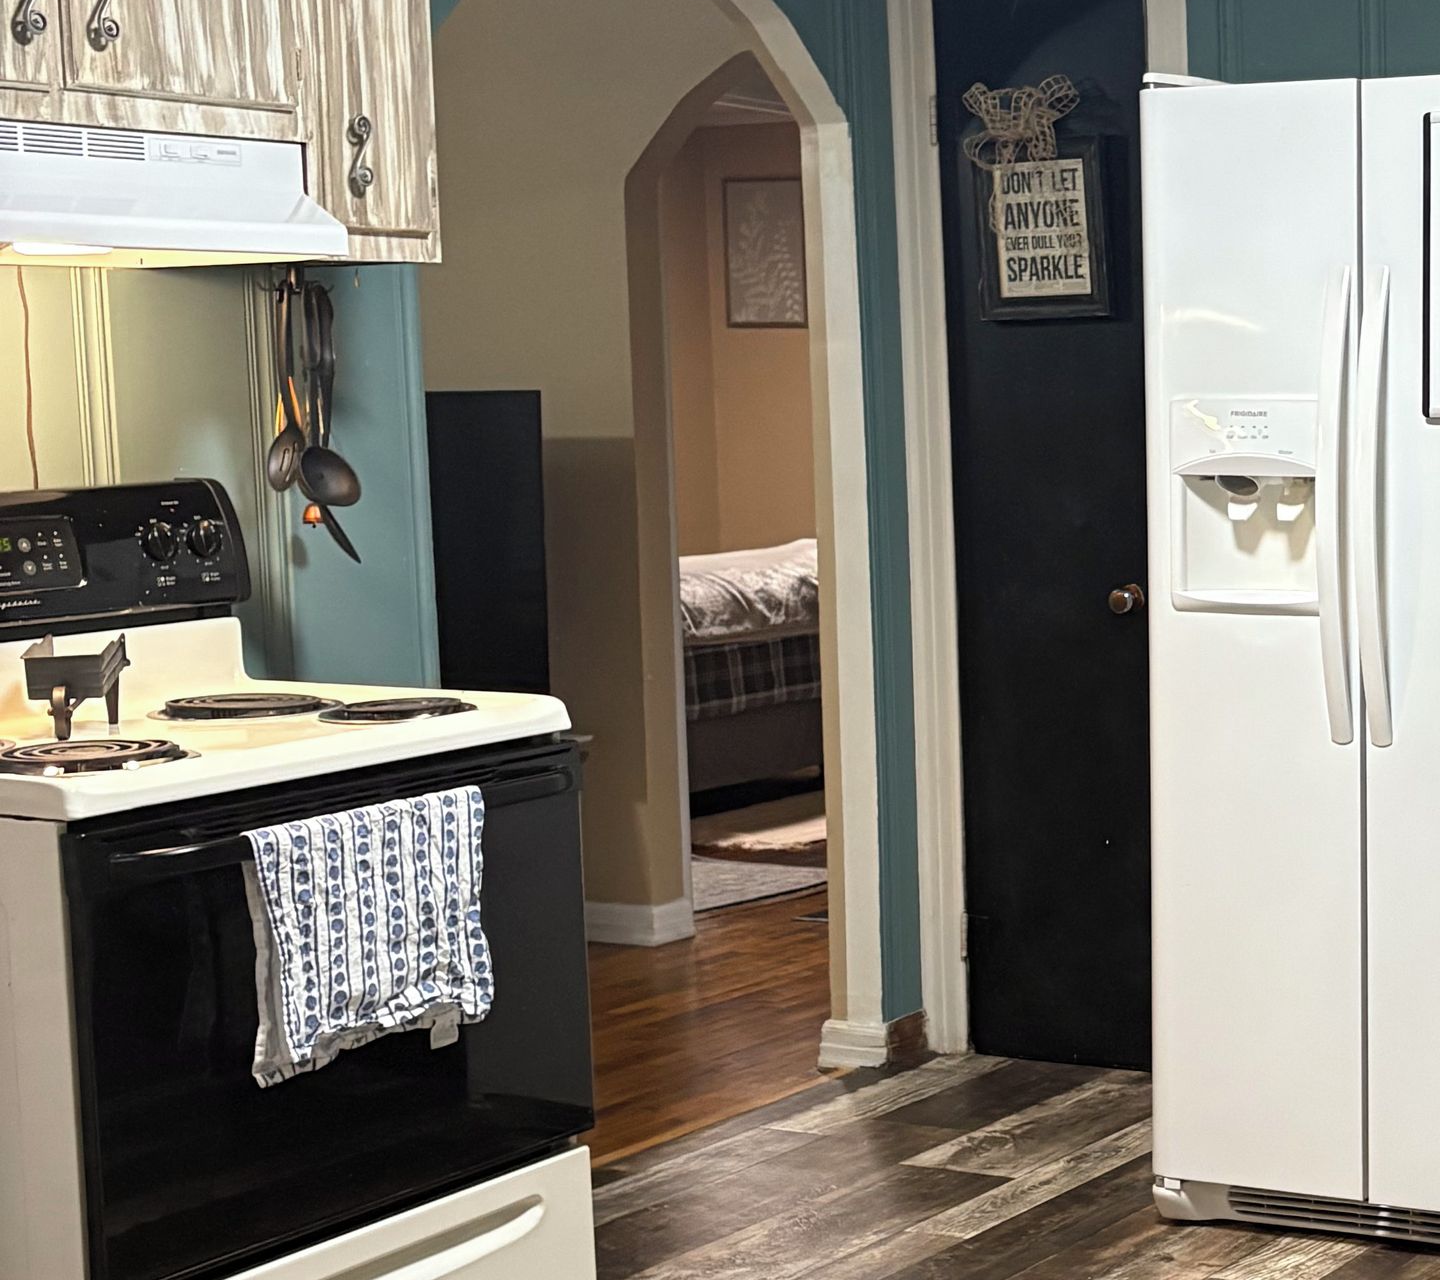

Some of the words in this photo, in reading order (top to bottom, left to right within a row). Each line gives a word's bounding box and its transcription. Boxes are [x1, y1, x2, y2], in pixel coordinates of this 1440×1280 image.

[1002, 170, 1043, 194] DON'T
[1052, 168, 1078, 192] LET
[1004, 198, 1080, 230] ANYONE
[1005, 236, 1029, 251] EVER
[1031, 235, 1055, 250] DULL
[1006, 254, 1085, 282] SPARKLE
[1230, 410, 1268, 418] FRIGIDAIRE
